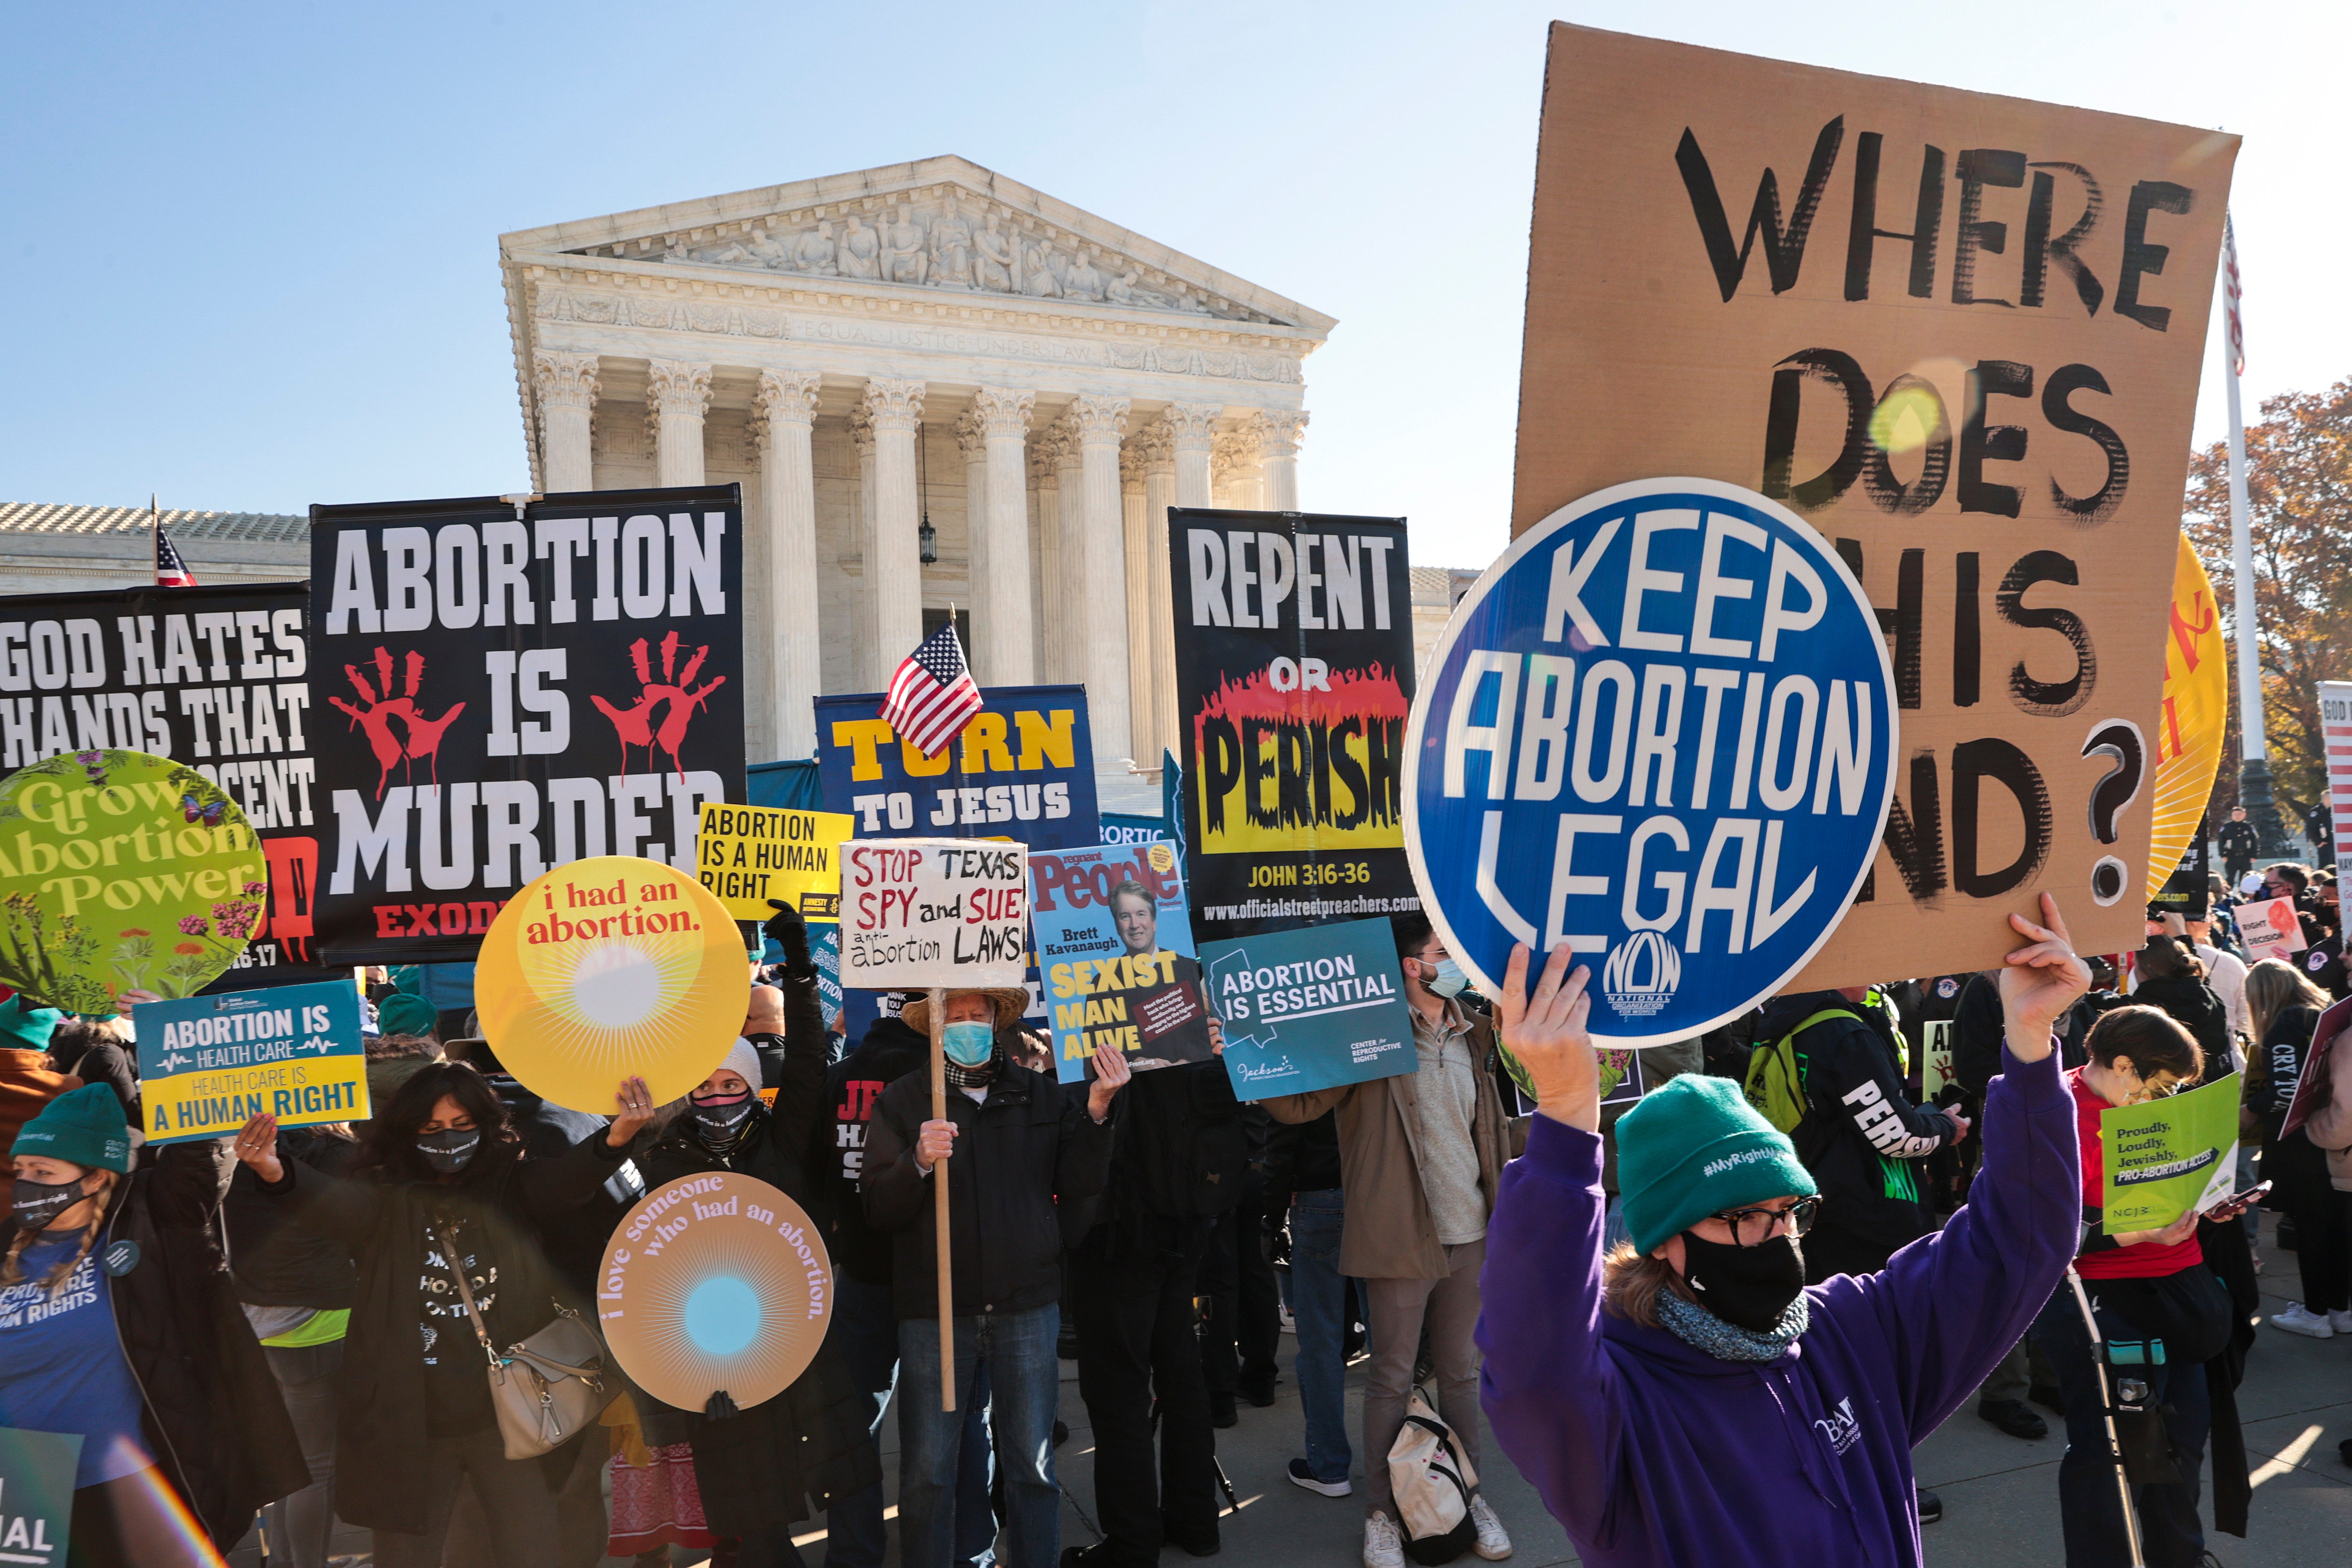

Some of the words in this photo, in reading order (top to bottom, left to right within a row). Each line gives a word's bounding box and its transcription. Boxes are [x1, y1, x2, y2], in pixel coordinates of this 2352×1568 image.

[1674, 114, 2194, 332] WHERE
[804, 321, 878, 342] EQUAL
[883, 328, 966, 350] JUSTICE
[977, 336, 1046, 357] UNDER
[1052, 343, 1090, 360] LAW
[1761, 347, 2130, 528] DOES
[326, 512, 725, 635] ABORTION
[1187, 529, 1394, 630] REPENT
[1543, 508, 1827, 662] KEEP
[1836, 538, 2097, 717] HIS
[0, 619, 106, 691] GOD
[117, 609, 306, 686] HATES
[1269, 656, 1332, 693] OR
[486, 648, 570, 757] IS
[0, 691, 171, 768] HANDS
[179, 683, 310, 757] THAT
[1443, 649, 1871, 816] ABORTION
[1202, 713, 1404, 837] PERISH
[18, 779, 189, 835] Grow
[703, 808, 815, 842] ABORTION
[853, 793, 914, 832] TO
[930, 782, 1070, 827] JESUS
[703, 840, 724, 866] IS
[733, 842, 747, 867] A
[755, 843, 827, 872] HUMAN
[852, 847, 923, 887] STOP
[939, 849, 1020, 880] TEXAS
[1063, 851, 1103, 866] regnant
[1248, 866, 1297, 887] JOHN
[1302, 862, 1371, 886] 3:16-36
[40, 864, 255, 916] Power
[543, 884, 553, 910] i
[566, 879, 627, 908] had
[640, 882, 678, 903] an
[701, 871, 771, 899] RIGHT
[1028, 847, 1179, 912] People
[1476, 811, 1817, 954] LEGAL
[373, 900, 511, 938] EXOD
[803, 897, 827, 907] AMNESTY
[857, 886, 918, 930] SPY
[919, 894, 961, 922] and
[966, 887, 1024, 925] SUE
[1204, 895, 1420, 921] www.officialstreetpreachers.com
[527, 905, 701, 945] abortion.
[854, 932, 889, 943] anti-
[1062, 927, 1099, 942] Brett
[2243, 920, 2266, 931] RIGHT
[2248, 932, 2285, 945] DECISION
[851, 935, 940, 967] abortion
[1046, 938, 1119, 956] Kavanaugh
[1603, 931, 1682, 993] NOW
[1050, 950, 1177, 999] SEXIST
[1223, 954, 1356, 996] ABORTION
[1055, 997, 1128, 1030] MAN
[1224, 997, 1250, 1021] IS
[1257, 974, 1396, 1016] ESSENTIAL
[162, 1009, 294, 1051] ABORTION
[302, 1005, 331, 1034] IS
[1064, 1025, 1142, 1061] ALIVE
[1351, 1039, 1378, 1049] CENTER
[196, 1045, 250, 1069] HEALTH
[254, 1040, 295, 1061] CARE
[1352, 1042, 1402, 1056] REPRODUCTIVE
[1353, 1054, 1378, 1063] RIGHTS
[2272, 1044, 2298, 1074] CRY
[192, 1074, 248, 1097] HEALTH
[247, 1068, 287, 1090] CARE
[292, 1066, 307, 1084] IS
[155, 1104, 170, 1131] A
[177, 1092, 263, 1128] HUMAN
[273, 1082, 357, 1117] RIGHT
[2117, 1122, 2171, 1139] Proudly,
[2118, 1138, 2165, 1154] Loudly,
[1703, 1147, 1782, 1177] #MyRightM
[2118, 1150, 2178, 1168] Jewishly,
[2118, 1159, 2188, 1182] PRO-ABORTION
[2188, 1148, 2213, 1167] ACCESS
[625, 1176, 724, 1242] someone
[600, 1248, 631, 1300] love
[644, 1216, 689, 1256] who
[692, 1195, 738, 1222] had
[746, 1204, 775, 1225] an
[778, 1221, 829, 1320] abortion.
[28, 1288, 97, 1324] RIGHTS
[600, 1310, 624, 1320] i
[0, 1515, 54, 1552] AL
